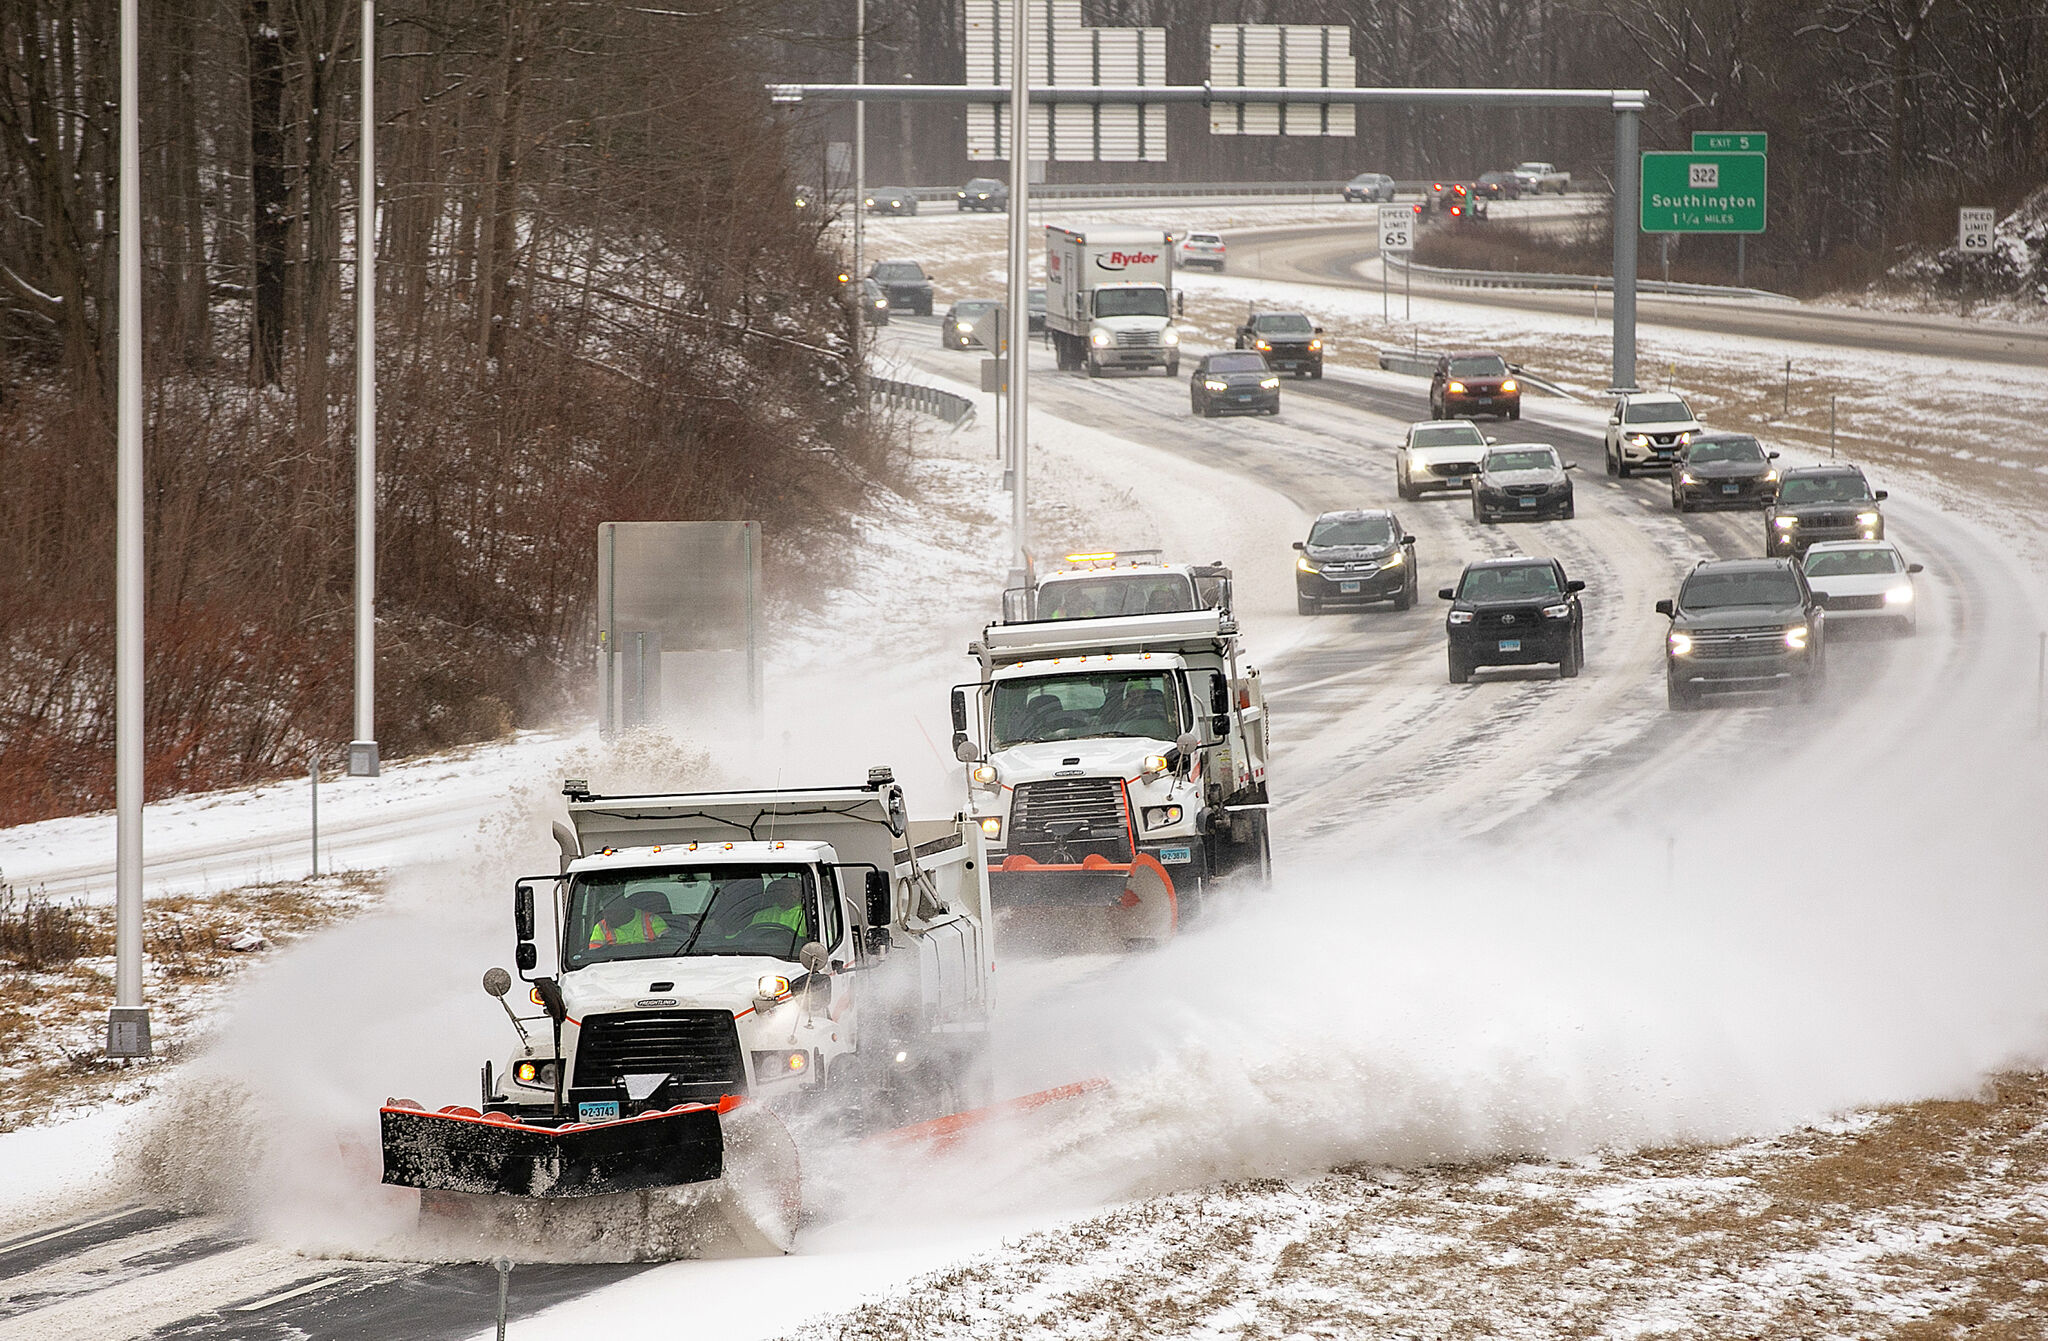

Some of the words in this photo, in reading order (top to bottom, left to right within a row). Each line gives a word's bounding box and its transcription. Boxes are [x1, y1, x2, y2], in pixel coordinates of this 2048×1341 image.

[1709, 138, 1731, 148] EXIT
[1740, 137, 1750, 149] 5
[1692, 168, 1716, 183] 322
[1652, 194, 1756, 211] Southington
[1382, 210, 1410, 218] SPEED
[1672, 213, 1678, 225] 1
[1704, 214, 1735, 224] MILES
[1962, 211, 1992, 221] SPEED
[1384, 221, 1407, 229] LIMIT
[1965, 223, 1988, 231] LIMIT
[1385, 231, 1407, 245] 65
[1965, 234, 1987, 248] 65
[1110, 251, 1159, 267] Ryder
